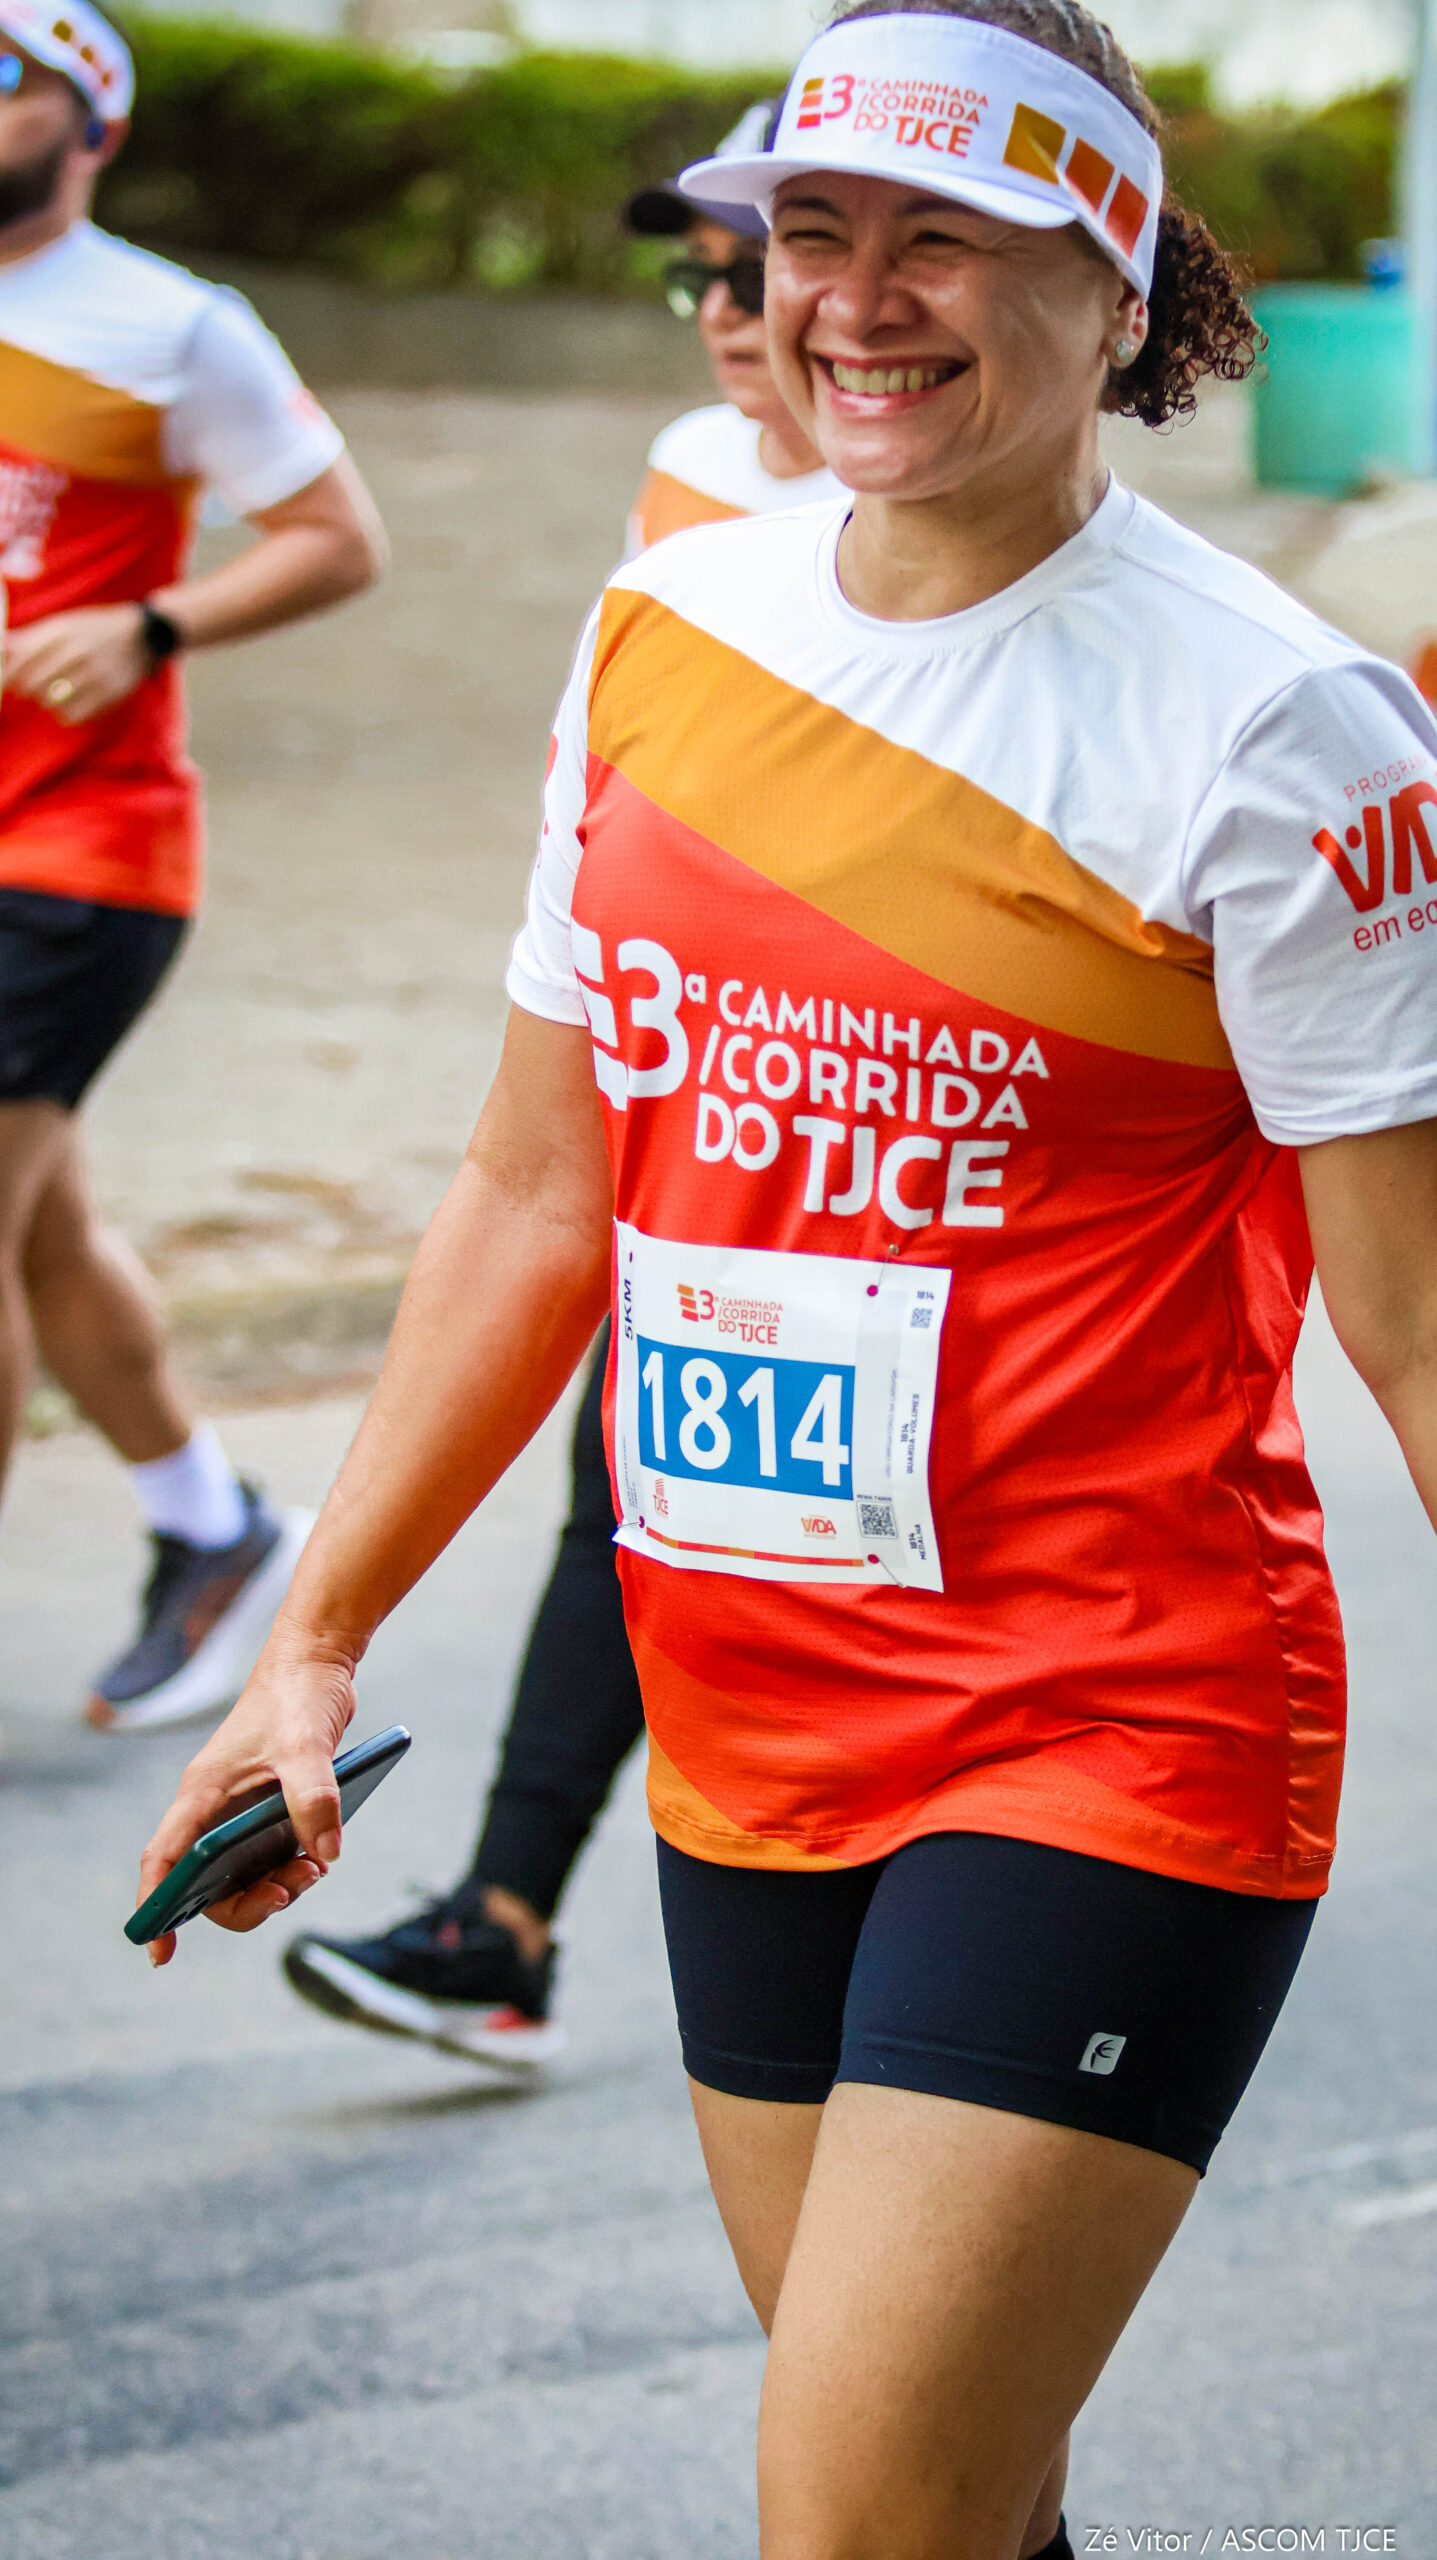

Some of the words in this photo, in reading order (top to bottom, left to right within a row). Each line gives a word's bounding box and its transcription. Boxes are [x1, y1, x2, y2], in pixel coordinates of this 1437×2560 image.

[858, 92, 981, 126] /CORRIDA
[870, 77, 989, 108] CAMINHADA
[853, 112, 889, 131] DO
[894, 115, 974, 158] TJCE
[1353, 915, 1402, 952] em
[718, 979, 1050, 1079] CAMINHADA
[699, 1024, 1029, 1130] /CORRIDA
[695, 1092, 781, 1171] DO
[793, 1114, 1010, 1230] TJCE
[624, 1278, 634, 1342] 5KM
[718, 1306, 780, 1324] /CORRIDA
[721, 1296, 783, 1312] CAMINHADA
[718, 1319, 737, 1333] DO
[738, 1322, 778, 1345] TJCE
[642, 1350, 850, 1487] 1814
